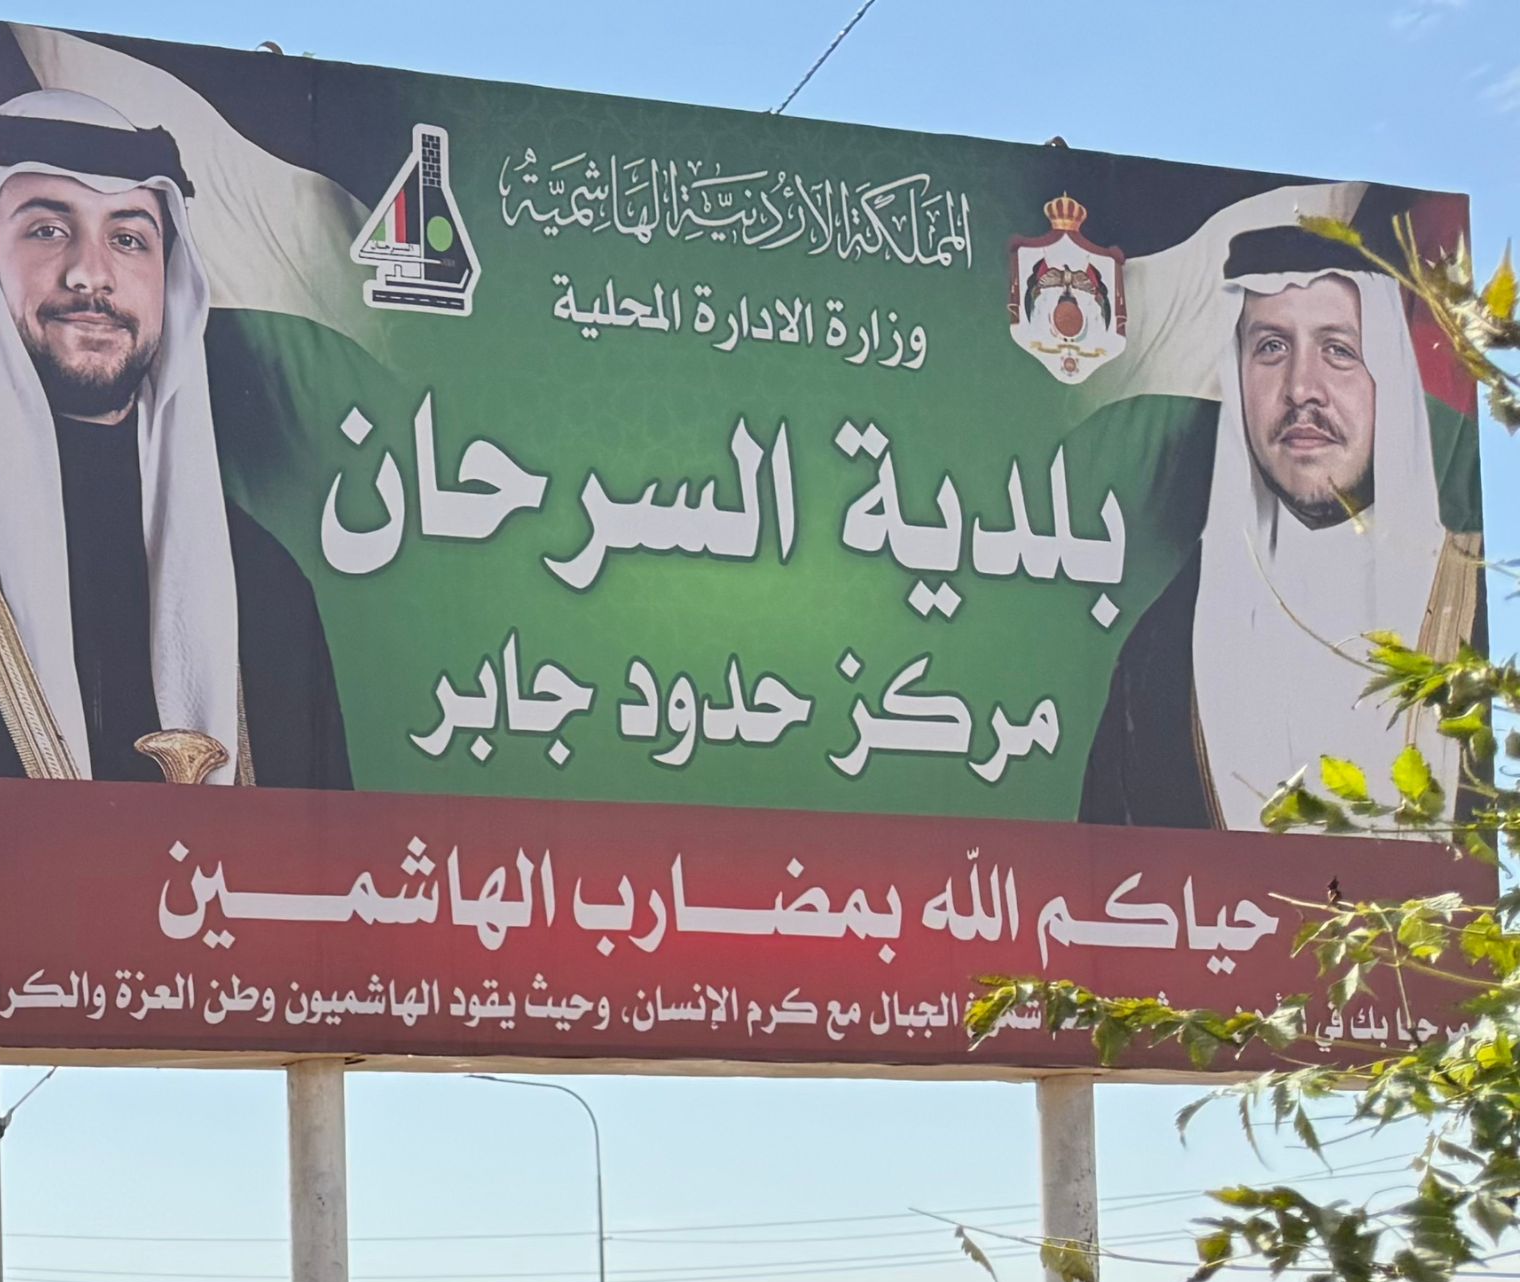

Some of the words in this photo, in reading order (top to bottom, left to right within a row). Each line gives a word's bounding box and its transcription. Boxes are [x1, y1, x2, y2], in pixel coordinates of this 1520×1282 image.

[499, 147, 678, 245] الهاشمية
[836, 173, 972, 268] المملكة
[553, 274, 680, 339] المحلية
[826, 298, 927, 369] وزارة
[320, 391, 795, 589] السرحان
[834, 419, 1126, 628] بلدية
[410, 629, 594, 765] جابر
[619, 656, 813, 765] حدود
[828, 652, 1060, 782] مركز
[573, 853, 904, 964] بمضارب
[922, 847, 1019, 942] الله
[1037, 872, 1280, 976] حياكم
[115, 969, 195, 1020] العزة
[203, 974, 277, 1024] وطن
[284, 973, 440, 1026] الهاشميون
[450, 979, 517, 1030] يقود
[524, 973, 611, 1031] وحيث
[747, 987, 819, 1037] كرم
[826, 999, 861, 1040] مع
[870, 990, 959, 1038] الجبال
[1315, 1001, 1345, 1052] في
[1350, 1005, 1389, 1049] بك
